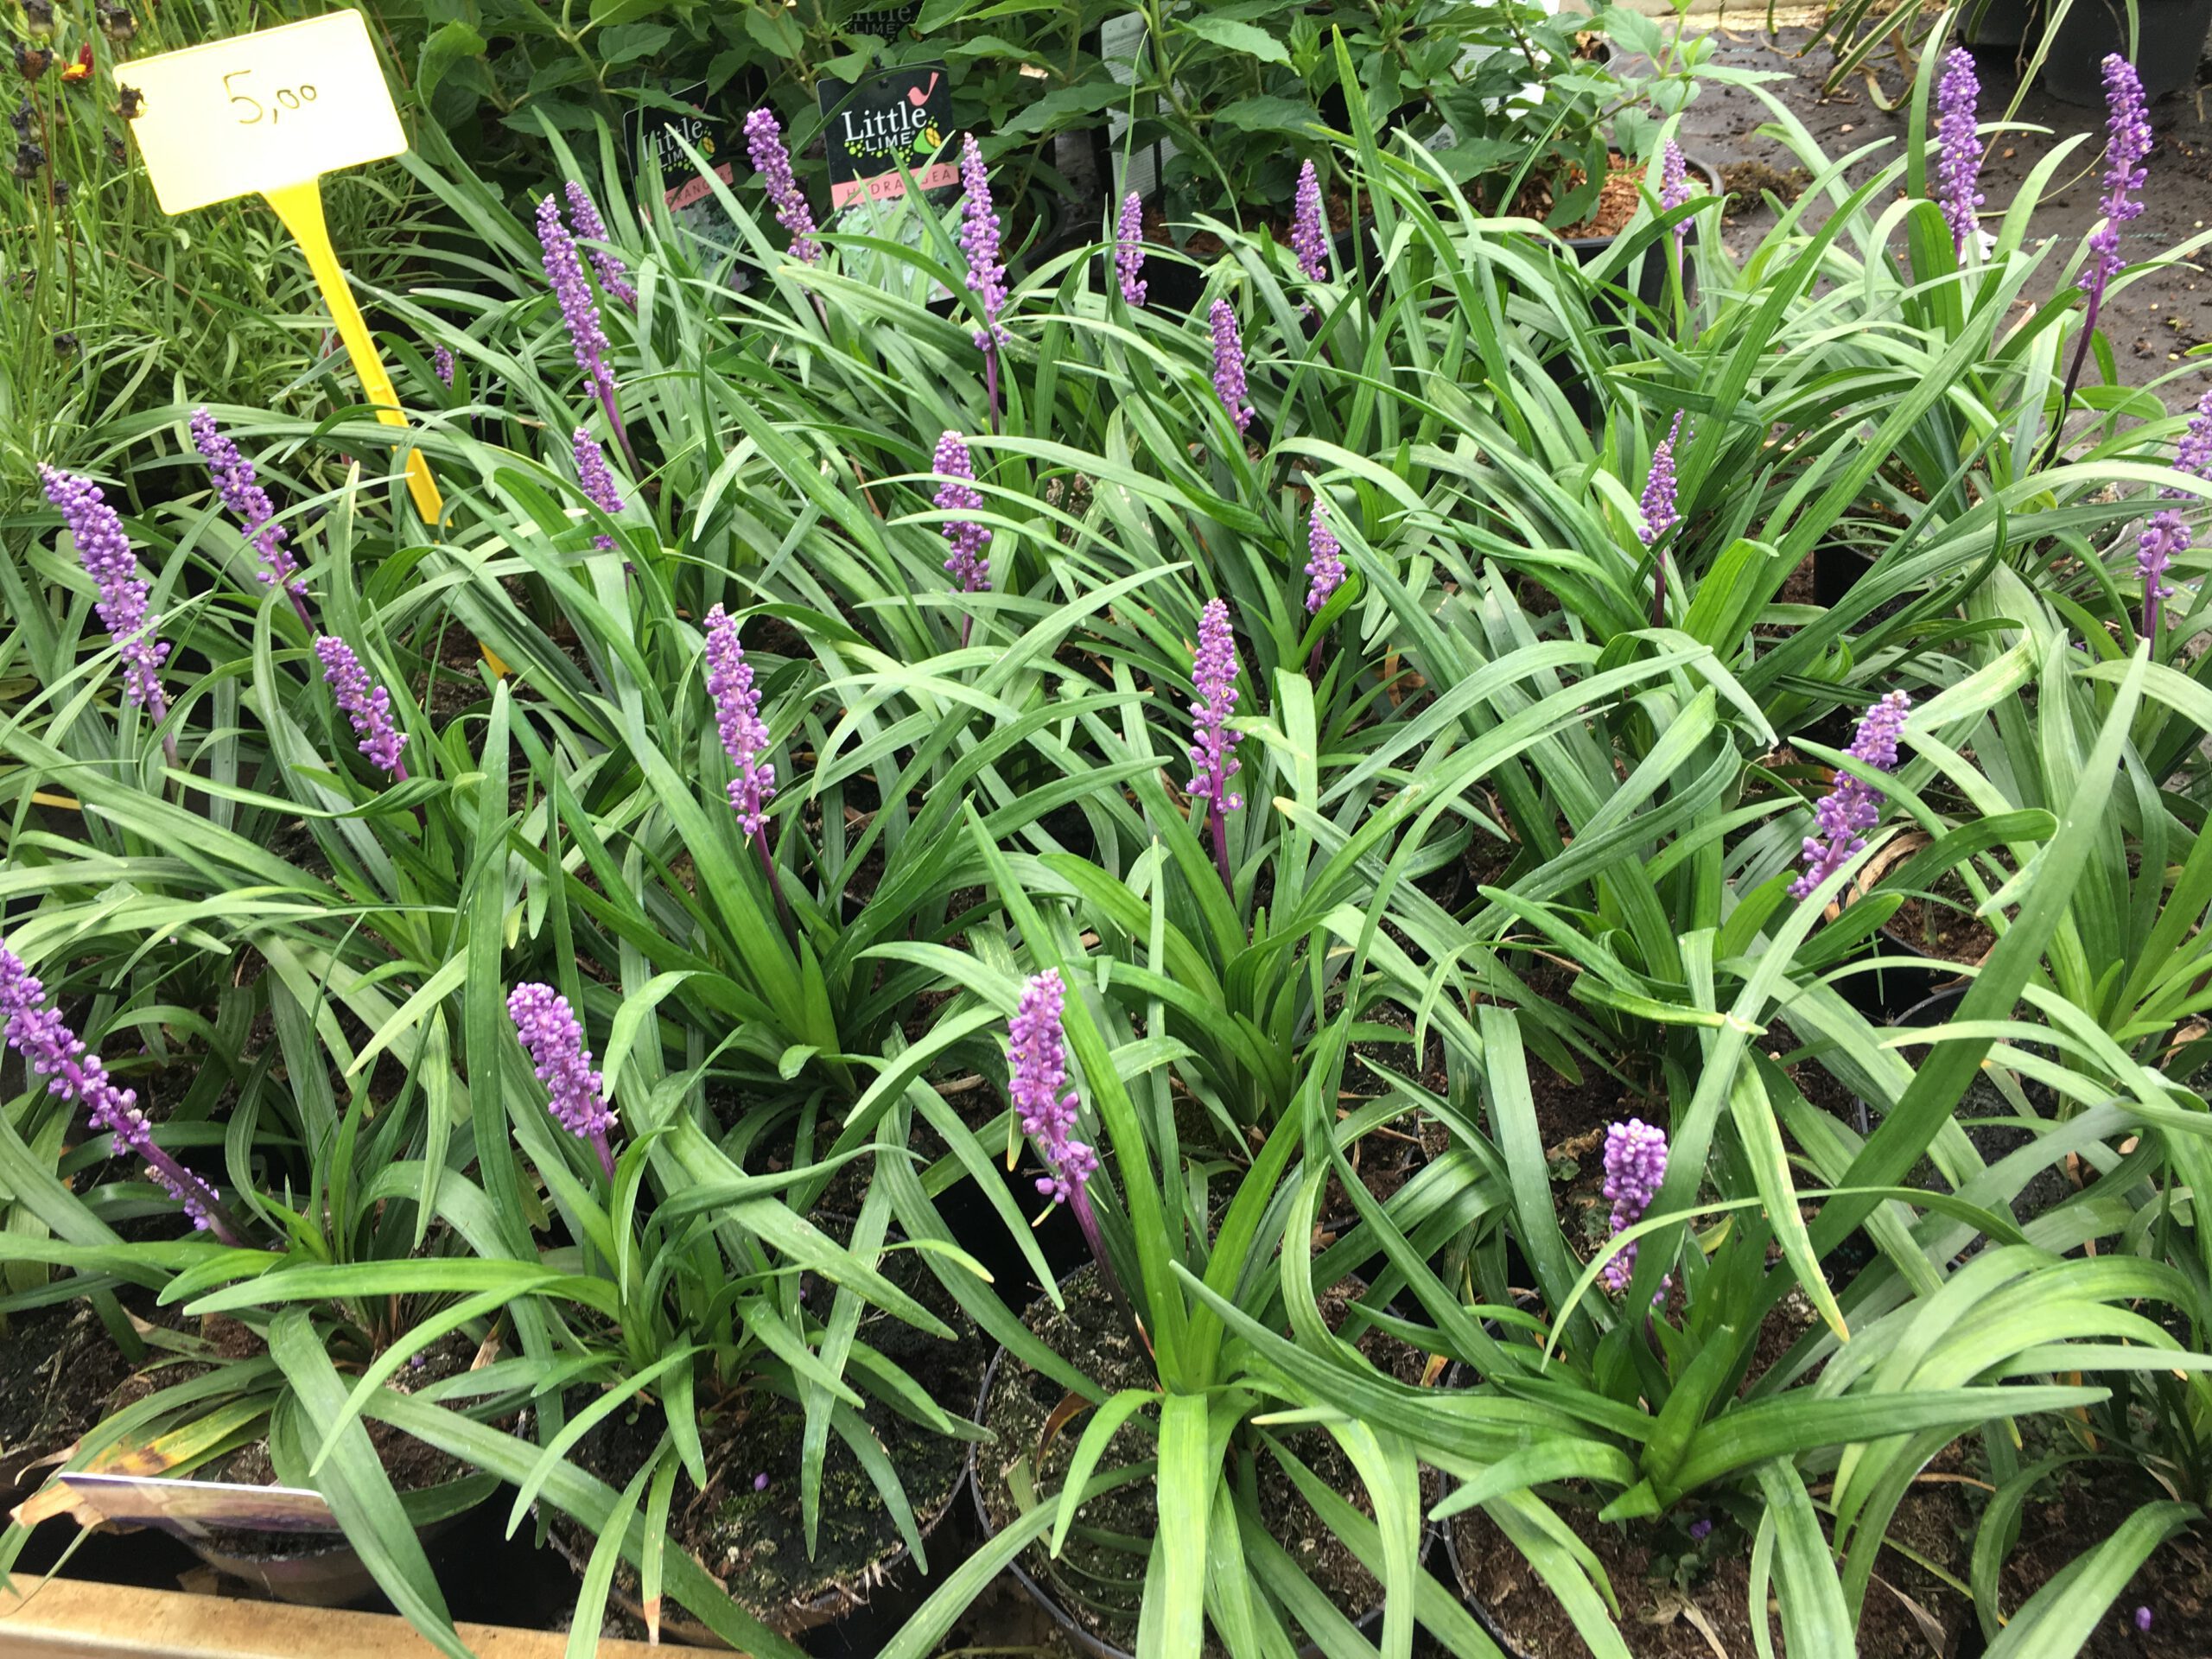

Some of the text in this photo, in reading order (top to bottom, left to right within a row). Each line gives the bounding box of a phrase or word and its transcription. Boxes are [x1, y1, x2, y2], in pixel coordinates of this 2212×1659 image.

[854, 22, 897, 35] LIME
[223, 69, 317, 124] 5,00
[841, 100, 927, 142] Little
[865, 130, 912, 152] LIME
